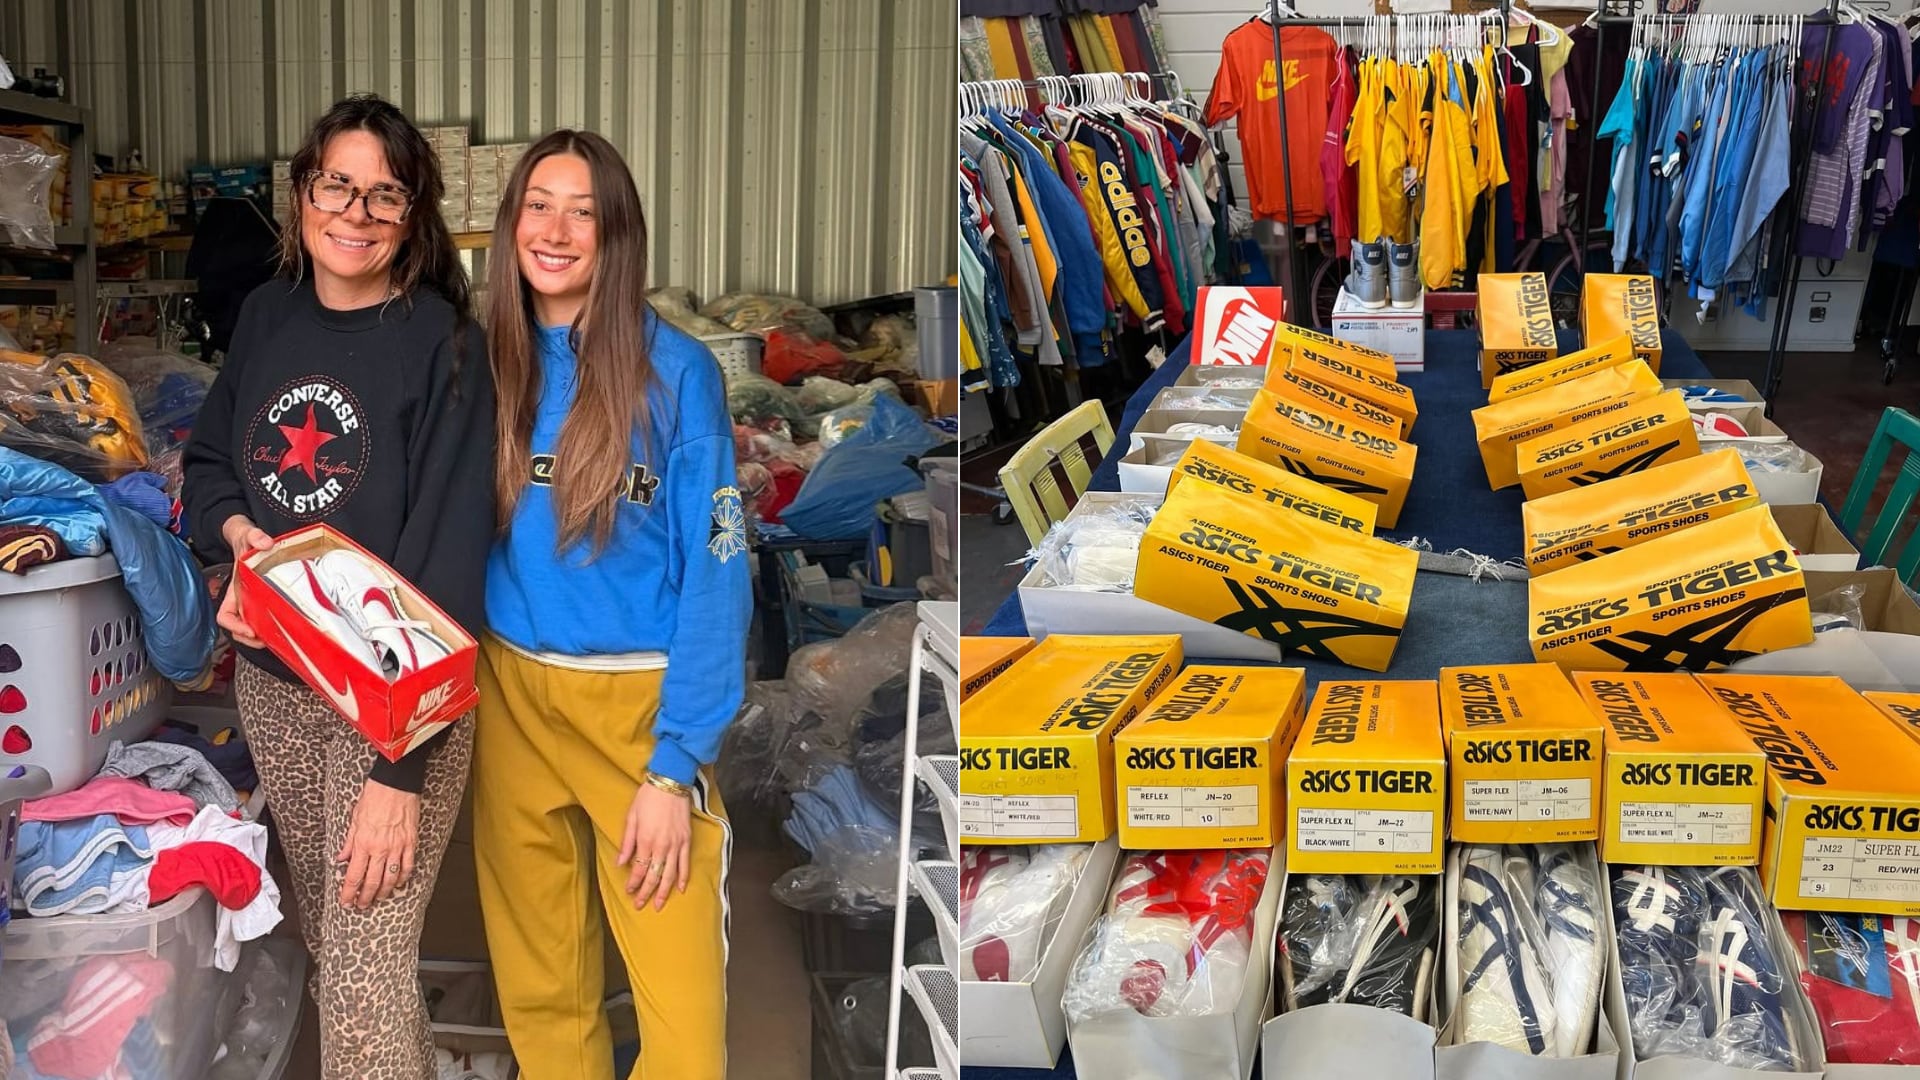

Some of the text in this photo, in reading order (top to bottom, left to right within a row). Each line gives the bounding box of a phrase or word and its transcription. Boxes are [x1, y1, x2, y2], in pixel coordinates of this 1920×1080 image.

[1100, 161, 1150, 267] adidas
[1521, 273, 1549, 318] TIGER
[1628, 278, 1654, 320] TIGER
[1286, 325, 1347, 348] TIGER
[1303, 348, 1365, 380] TIGER
[1516, 351, 1547, 360] TIGER
[1548, 353, 1613, 379] TIGER
[1283, 370, 1348, 408] TIGER
[268, 383, 359, 434] CONVERSE
[1275, 400, 1346, 440] TIGER
[1508, 430, 1531, 442] ASICS
[1531, 423, 1554, 434] TIGER
[1571, 408, 1601, 423] SPORTS
[1602, 400, 1629, 414] SHOES
[1588, 414, 1667, 446] TIGER
[315, 456, 356, 476] Taylor
[1259, 436, 1366, 477] ASICS TIGER SPORTS SHOES
[1543, 439, 1649, 479] ASICS TIGER SPORTS SHOES
[260, 472, 343, 513] ALL STAR
[1618, 483, 1754, 527] TIGER
[1624, 491, 1702, 517] SPORTS SHOES
[1262, 488, 1365, 533] TIGER
[1189, 518, 1257, 545] ASICS TIGER
[1532, 511, 1710, 565] ASICS TIGER SPORTS SHOES
[1158, 545, 1339, 608] ASICS TIGER SPORTS SHOES
[1179, 526, 1383, 607] asics TIGER
[1281, 551, 1360, 580] SPORTS SHOES
[1644, 559, 1734, 591] SPORTS SHOES
[1536, 549, 1799, 636] asics TIGER
[1537, 597, 1608, 617] ASICS TIGER
[1540, 590, 1747, 651] ASICS TIGER SPORTS SHOES
[964, 657, 1014, 695] SPORTS SHOES
[1093, 652, 1165, 690] TIGER
[416, 676, 456, 717] NIKE
[1123, 704, 1138, 725] TIGER
[1144, 676, 1162, 701] SPORTS
[1144, 694, 1213, 722] TIGER
[1461, 693, 1506, 728] TIGER
[1312, 704, 1362, 746] TIGER
[1602, 702, 1660, 743] TIGER
[996, 747, 1071, 770] TIGER
[1126, 747, 1258, 770] asics TIGER
[1464, 739, 1591, 763] asics TIGER
[1739, 720, 1827, 785] TIGER
[1300, 770, 1432, 794] asics TIGER
[1621, 763, 1754, 786] asics TIGER
[1201, 815, 1213, 823] 10
[1300, 817, 1323, 825] SUPER
[1325, 817, 1342, 825] FLEX
[1540, 808, 1550, 816] 10
[1804, 804, 1864, 831] asics
[1378, 838, 1385, 846] 8
[1817, 844, 1843, 853] JM22
[1864, 844, 1901, 855] SUPER
